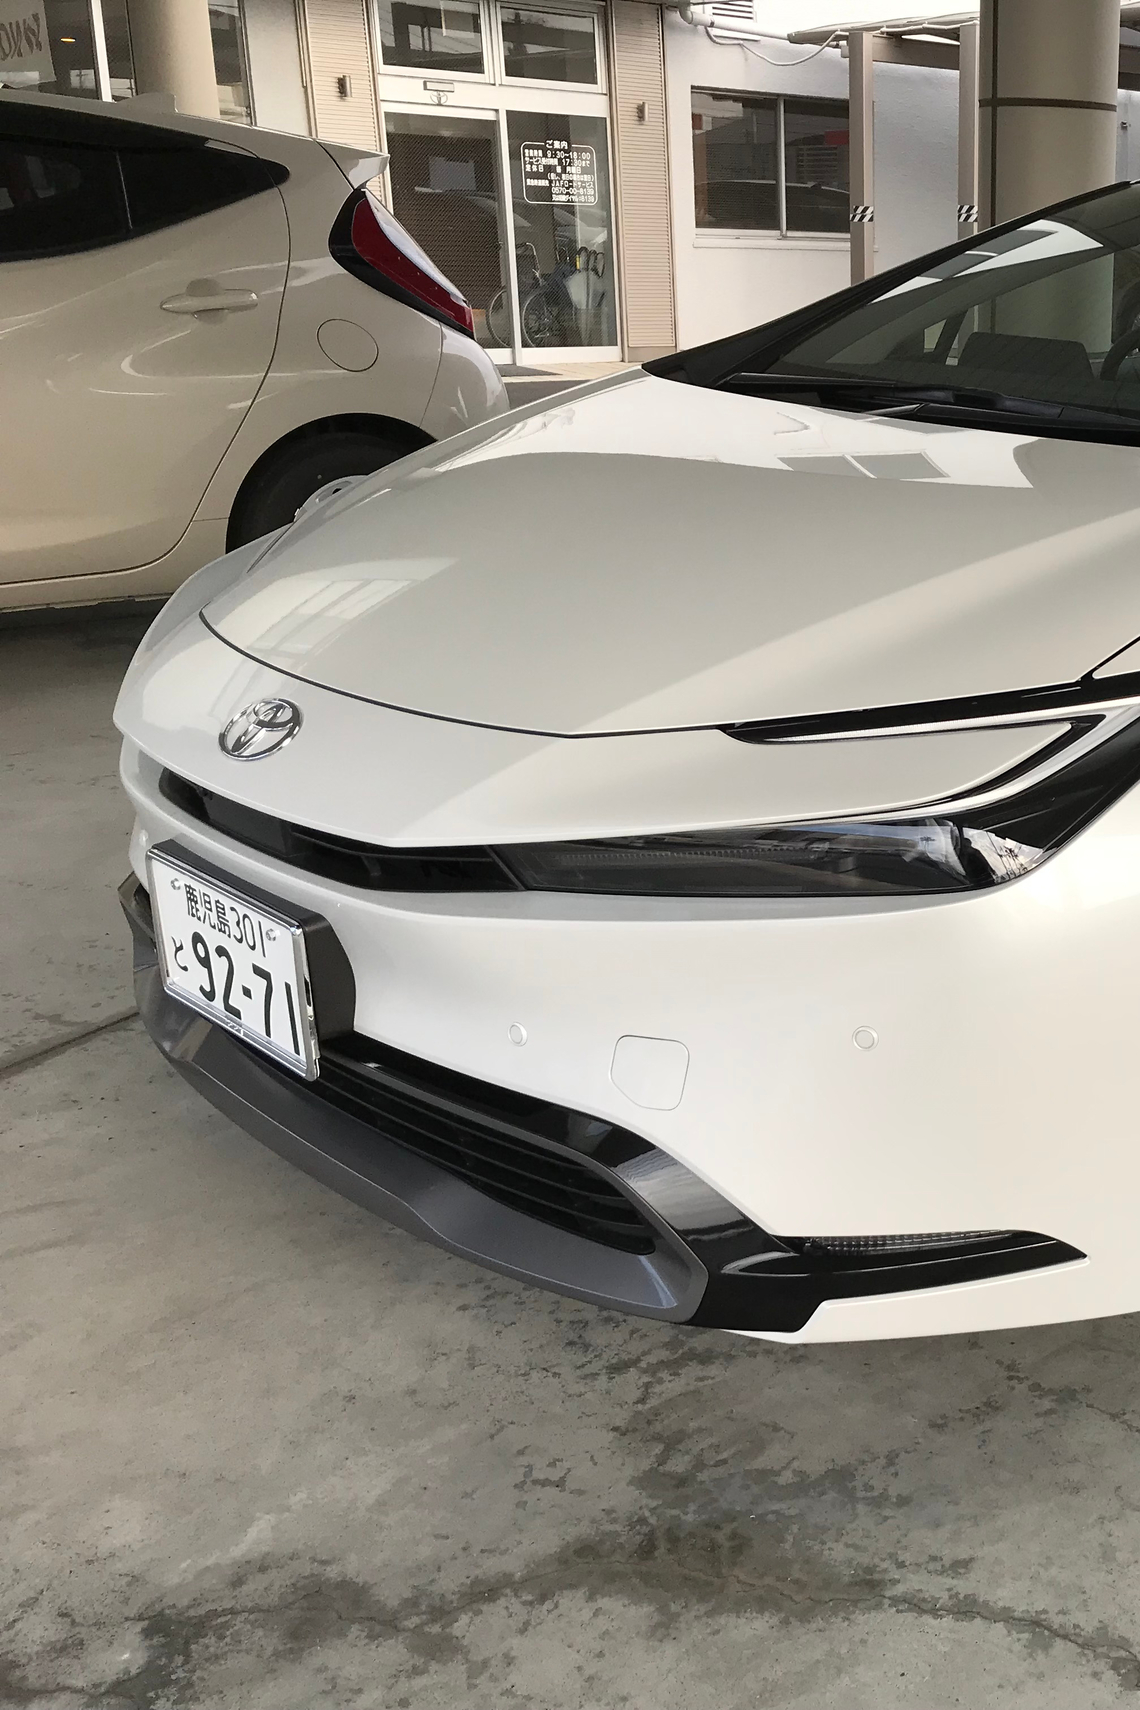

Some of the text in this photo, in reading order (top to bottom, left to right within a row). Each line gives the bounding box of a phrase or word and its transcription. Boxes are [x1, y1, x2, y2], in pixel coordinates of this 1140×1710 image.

[546, 140, 568, 149] ご案内
[171, 931, 301, 1057] と 92-71
